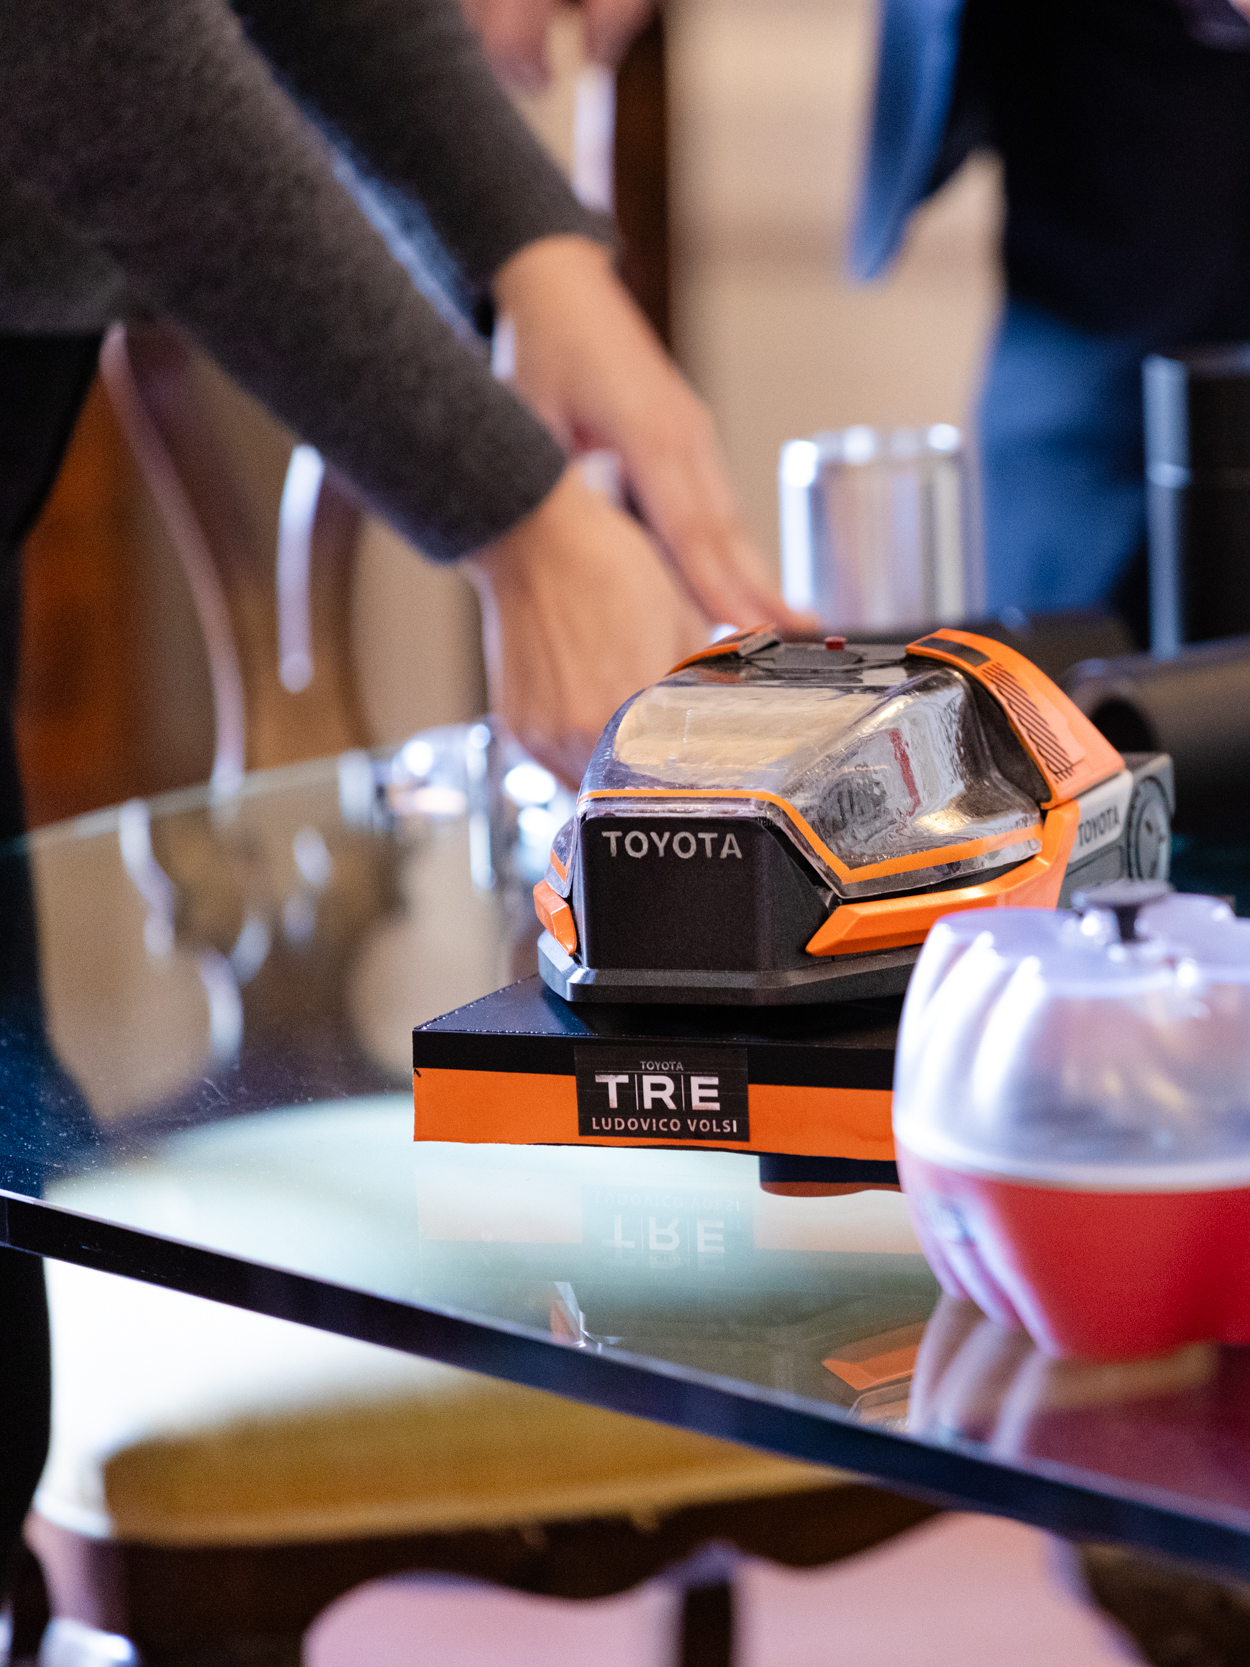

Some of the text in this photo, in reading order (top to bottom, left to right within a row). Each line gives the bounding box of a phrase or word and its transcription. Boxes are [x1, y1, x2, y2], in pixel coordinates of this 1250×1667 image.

[1077, 805, 1120, 848] TOYOTA
[601, 830, 743, 859] TOYOTA
[639, 1060, 684, 1071] TOYOTA
[595, 1074, 721, 1111] TRE
[592, 1117, 738, 1133] LUDOVICO VOLSI
